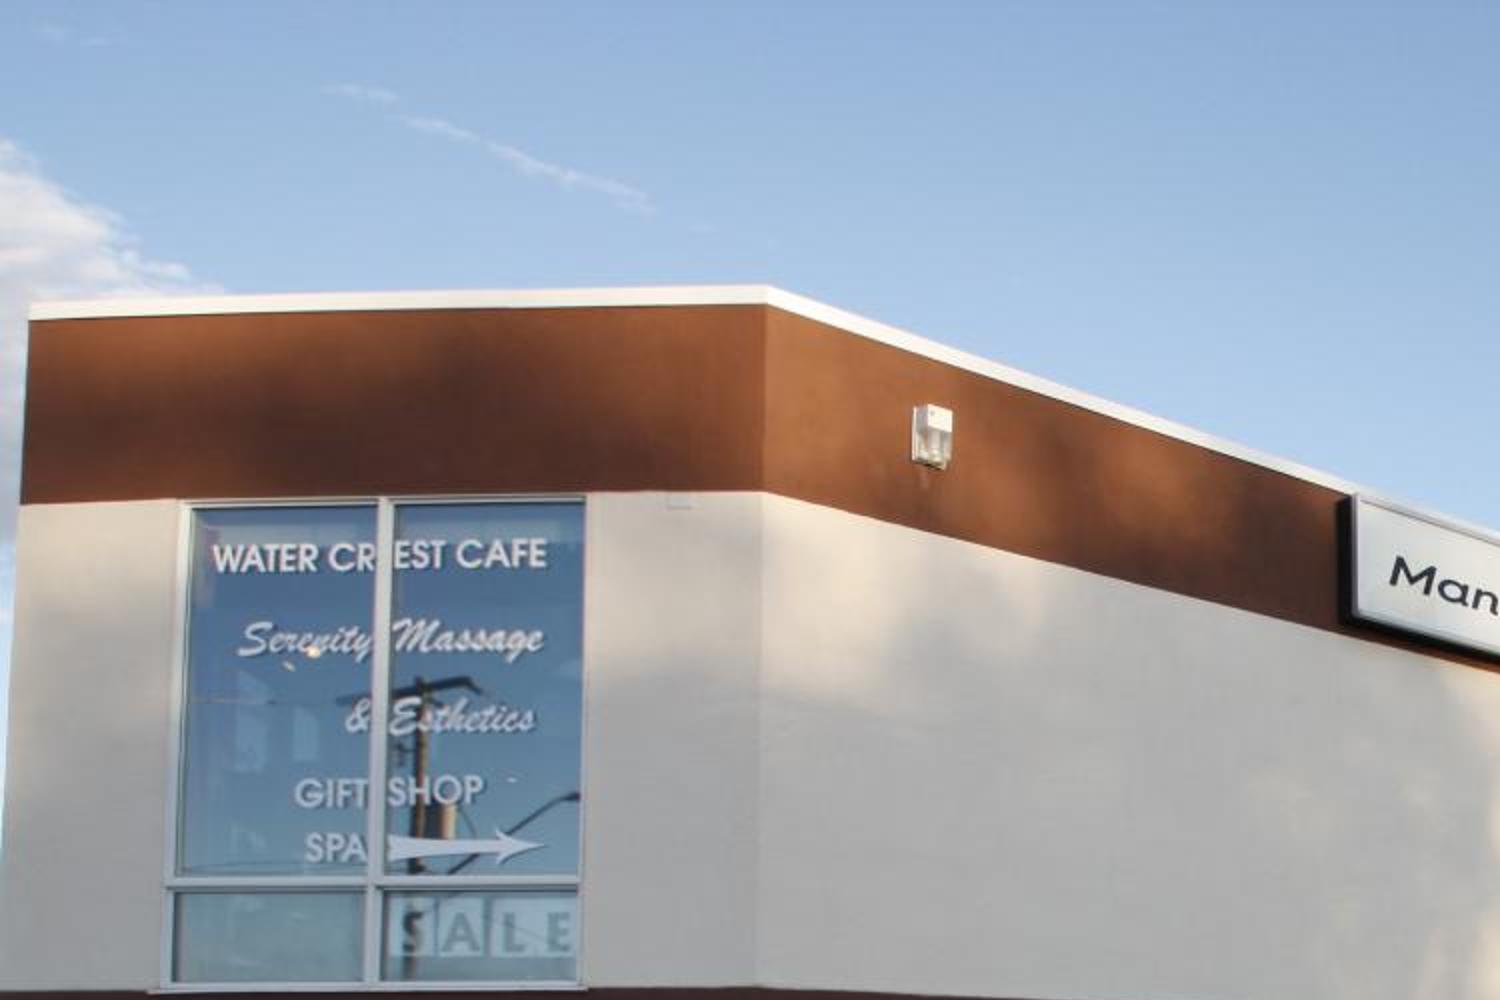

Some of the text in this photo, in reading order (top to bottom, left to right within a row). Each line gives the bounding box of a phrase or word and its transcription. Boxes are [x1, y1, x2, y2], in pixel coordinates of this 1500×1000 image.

[212, 543, 320, 574] WATER
[456, 538, 548, 569] CAFE
[238, 617, 545, 664] Serenity Massage
[344, 696, 536, 736] & Esthetics
[295, 774, 485, 809] GIFT SHOP
[304, 832, 369, 864] SPA
[401, 911, 572, 953] SALE
